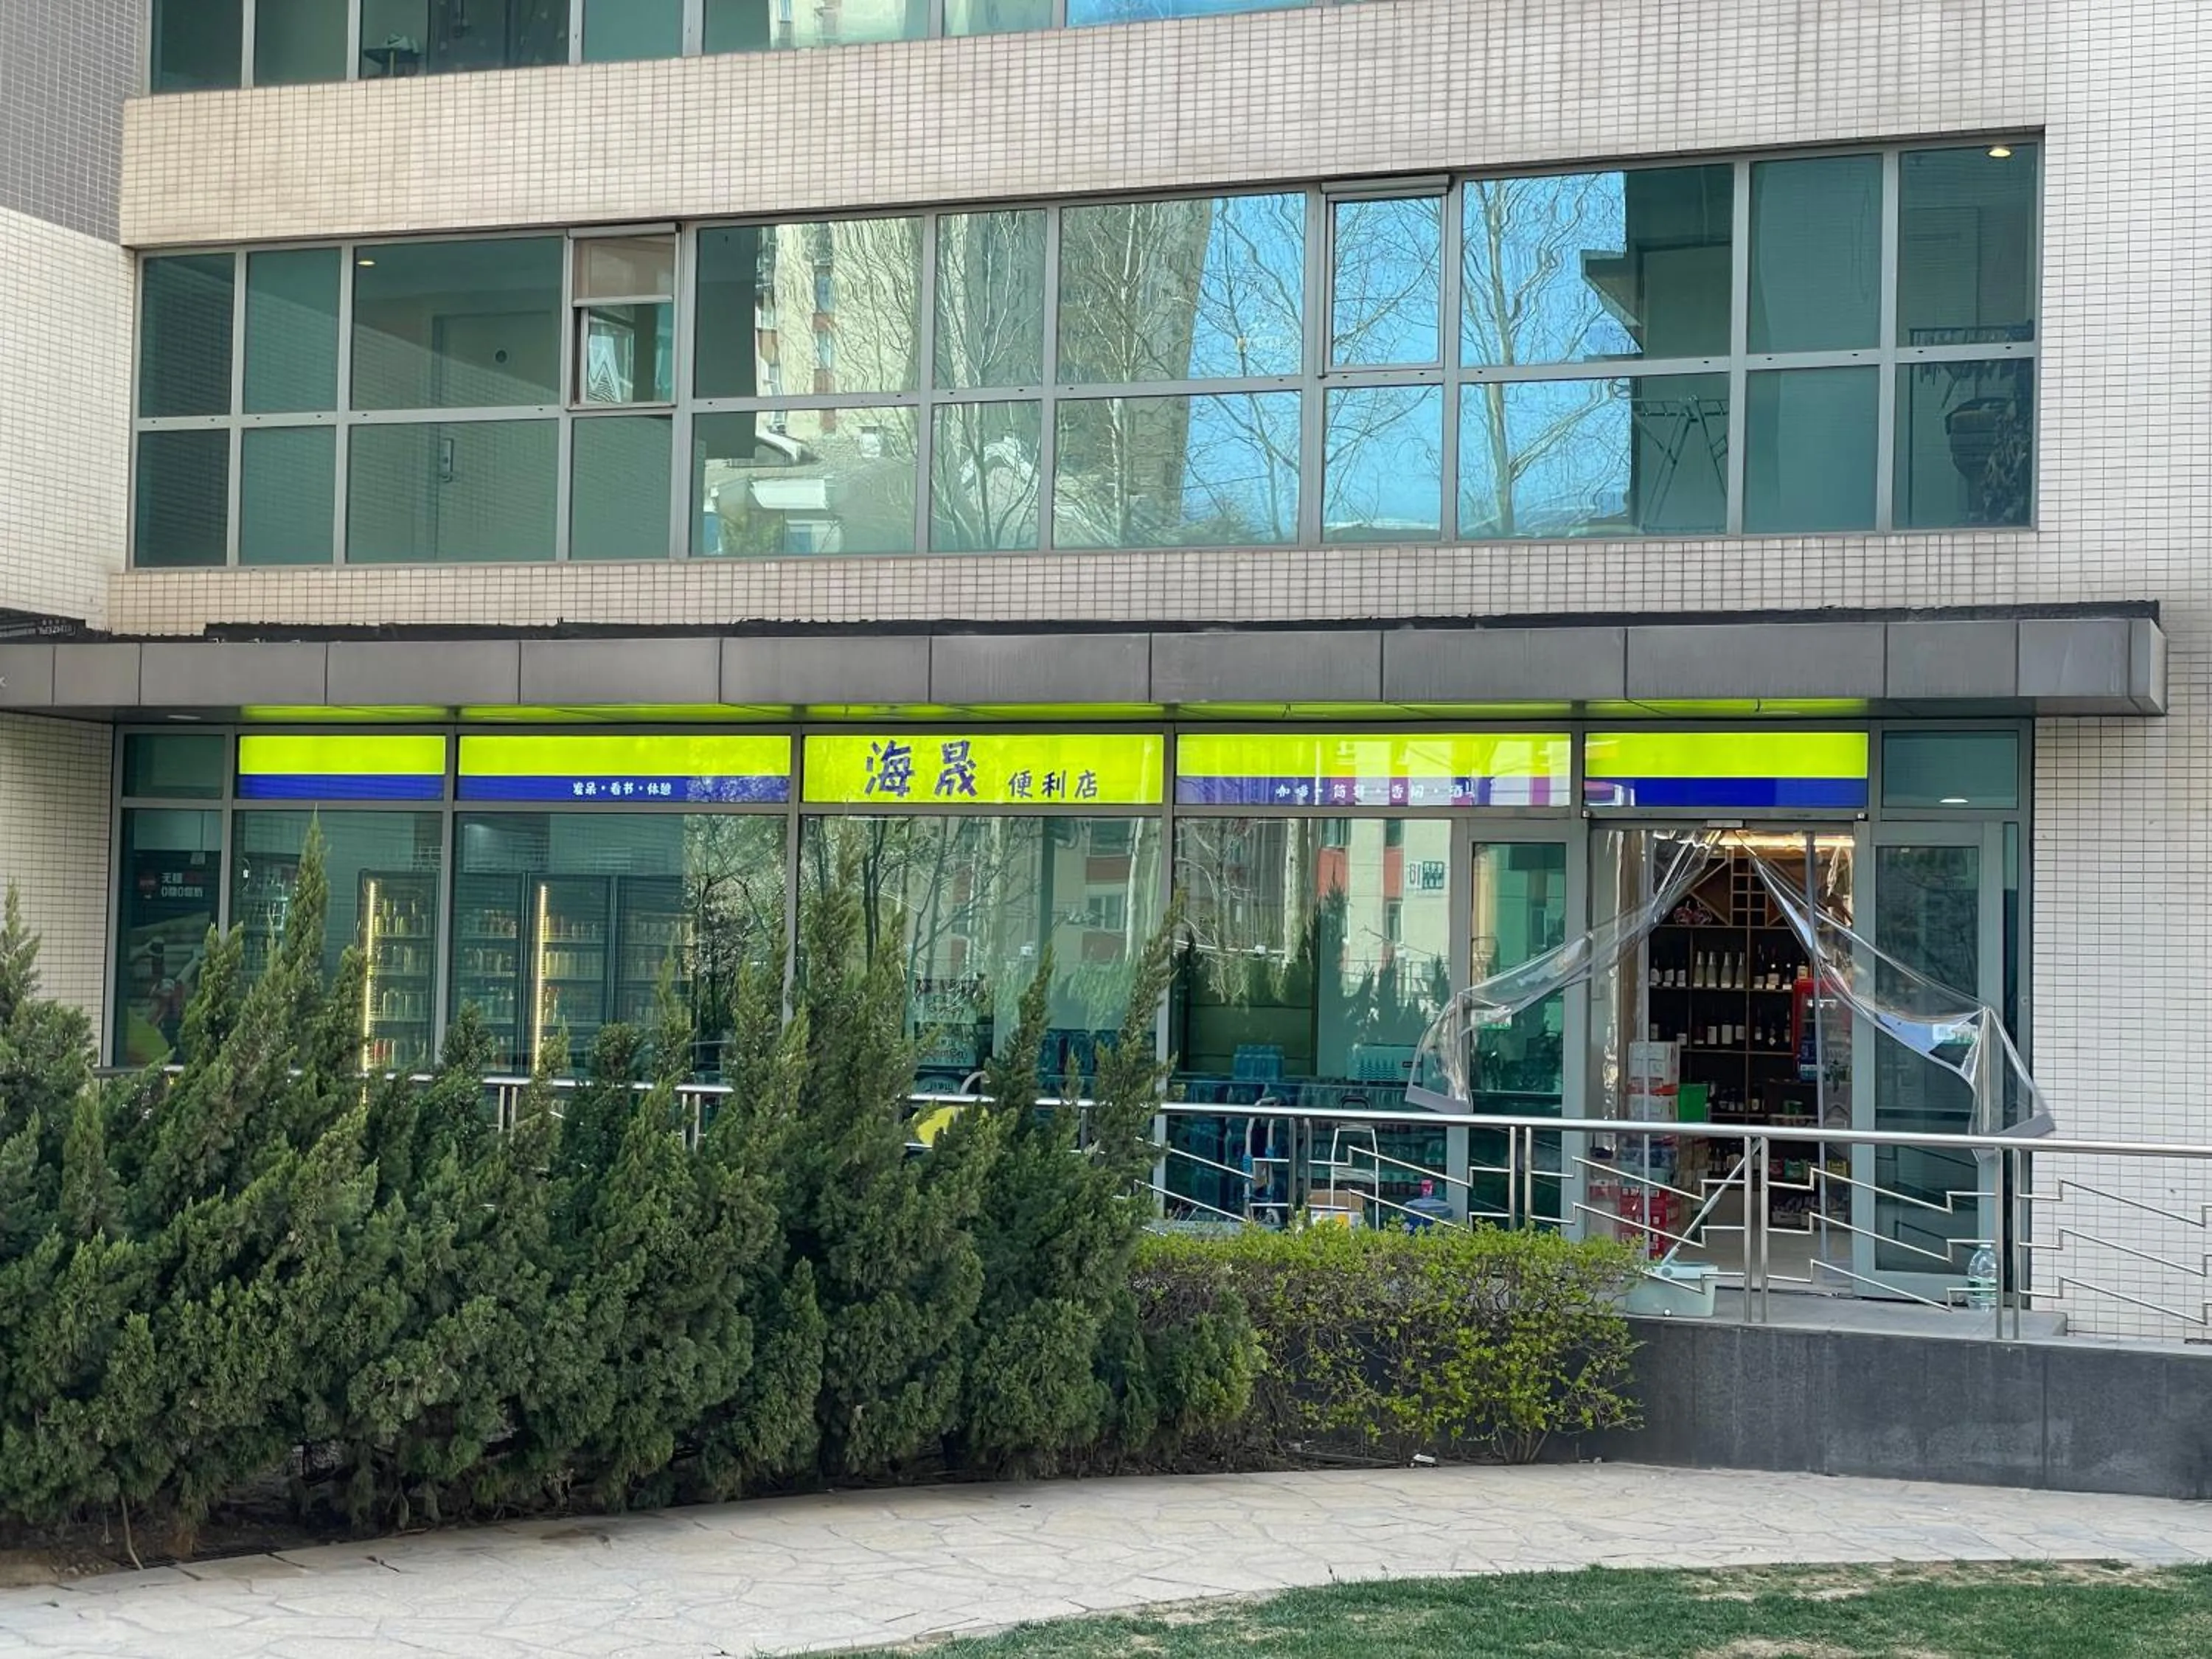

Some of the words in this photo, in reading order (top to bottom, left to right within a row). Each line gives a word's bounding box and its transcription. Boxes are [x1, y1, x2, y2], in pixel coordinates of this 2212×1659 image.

[865, 739, 978, 797] 海晟
[1008, 769, 1098, 799] 便利店
